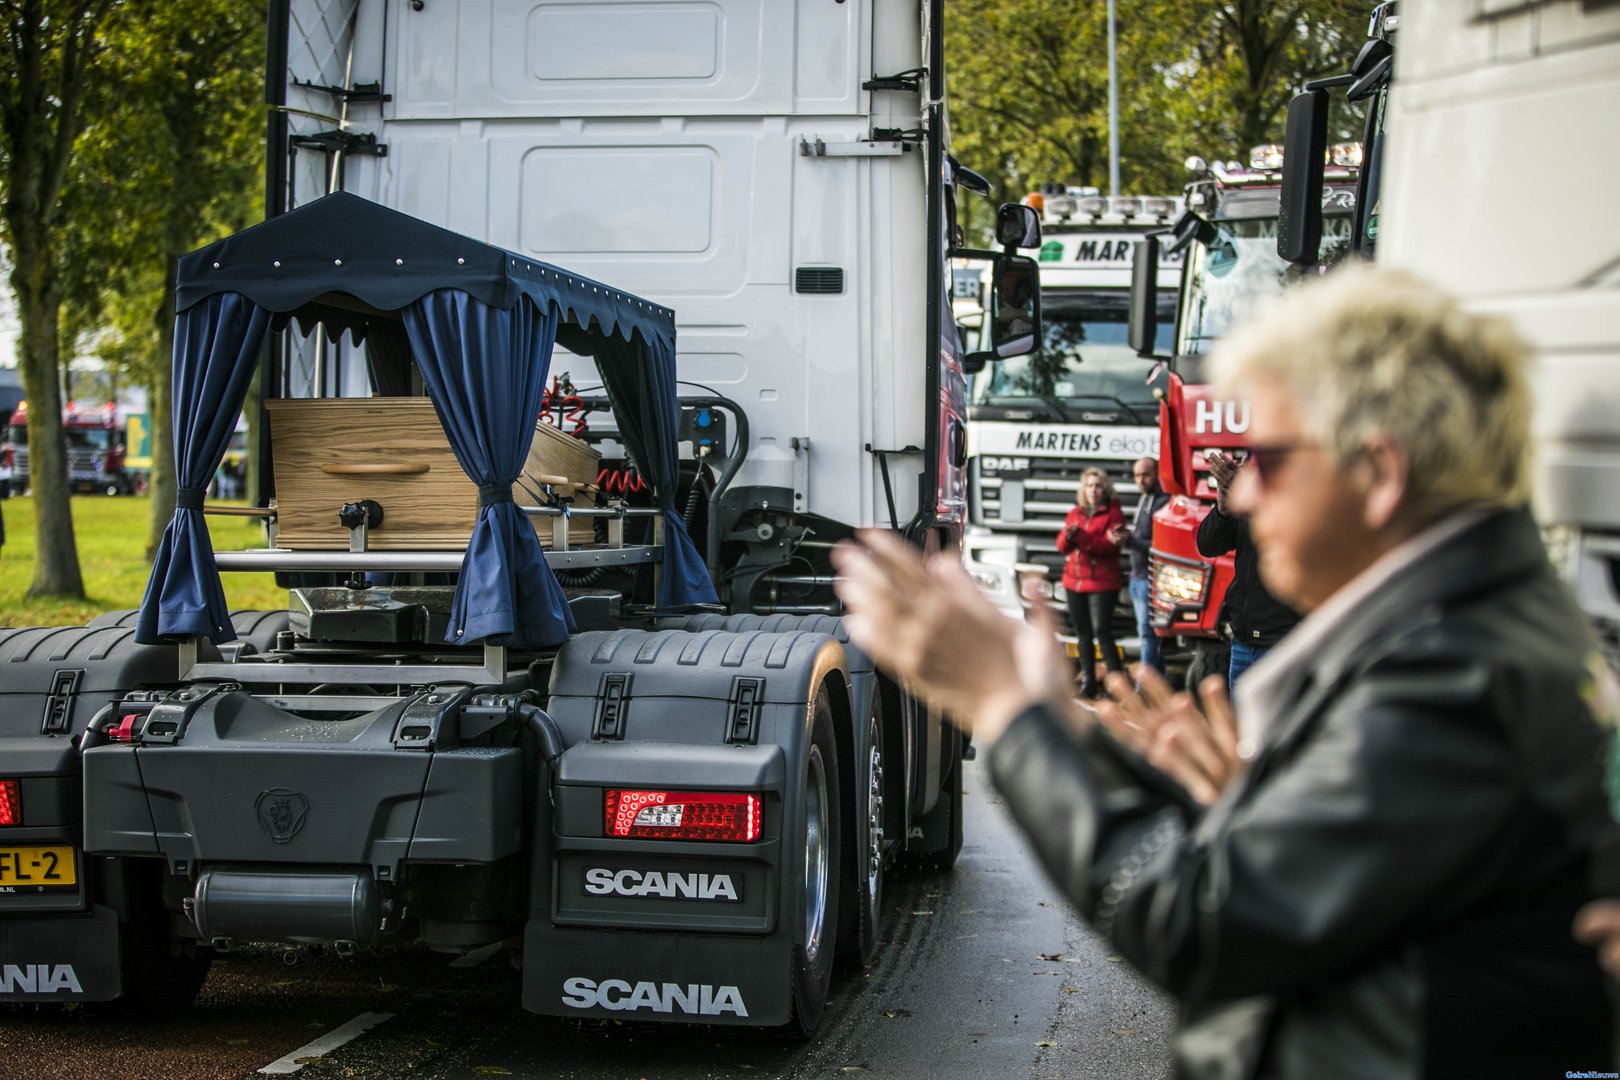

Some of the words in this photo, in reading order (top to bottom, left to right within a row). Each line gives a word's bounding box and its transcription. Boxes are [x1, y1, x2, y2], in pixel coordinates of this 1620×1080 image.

[1195, 399, 1250, 434] HU
[1016, 431, 1102, 451] MARTENS
[1109, 435, 1146, 454] eko
[982, 457, 1030, 471] DAF
[584, 867, 738, 900] SCANIA
[0, 964, 83, 993] NIA
[561, 976, 749, 1018] SCANIA
